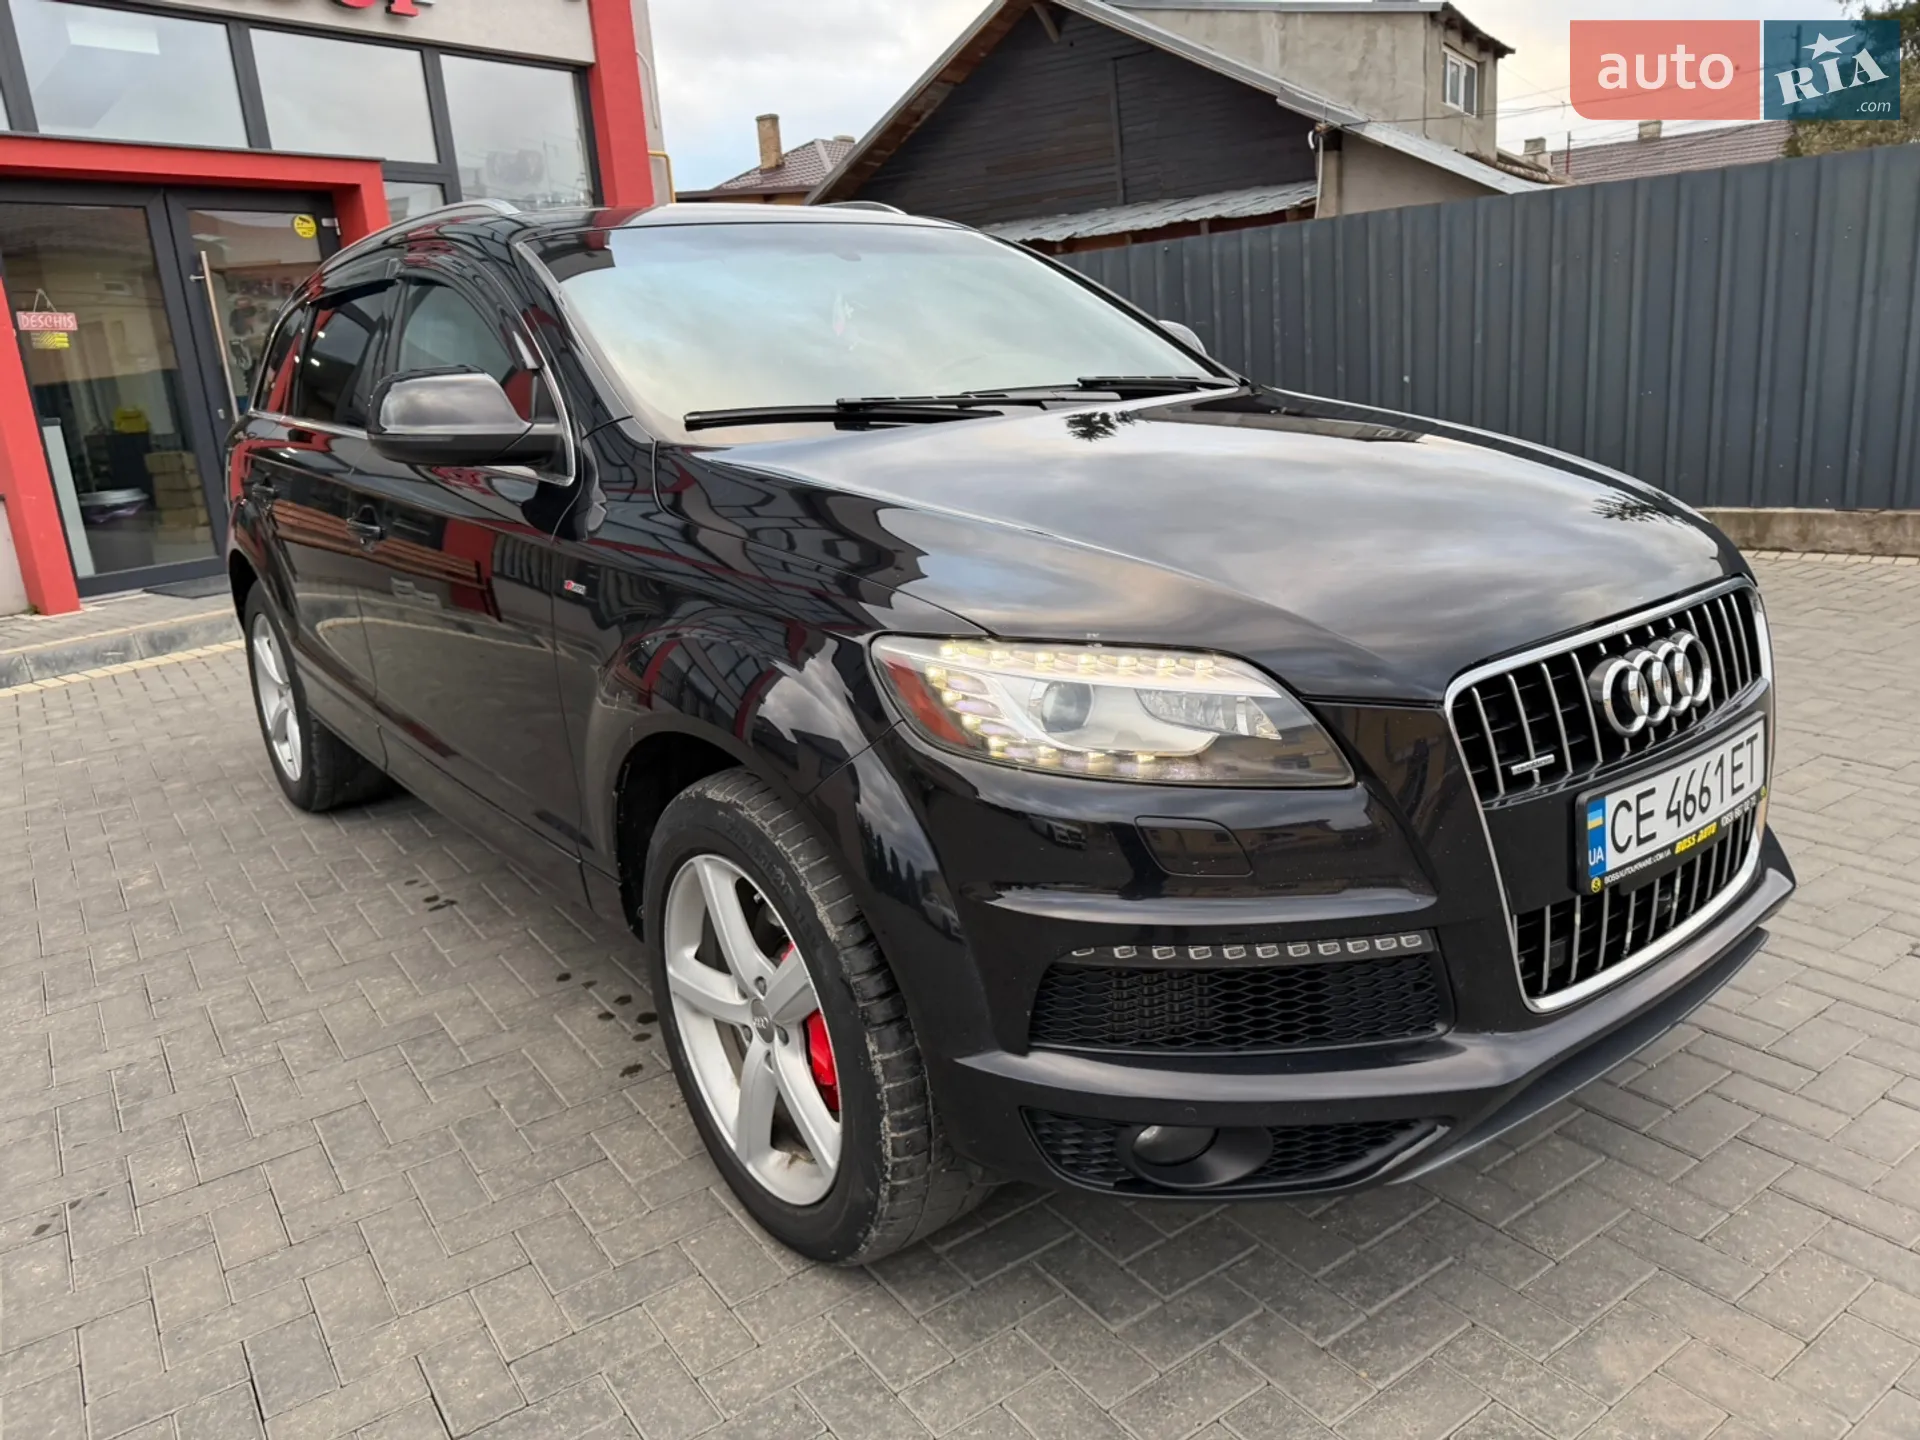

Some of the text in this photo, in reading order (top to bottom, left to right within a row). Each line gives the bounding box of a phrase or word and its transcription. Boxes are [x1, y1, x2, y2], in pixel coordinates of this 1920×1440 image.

[21, 314, 75, 328] DESCHIS
[1611, 787, 1657, 854] CE
[1588, 846, 1604, 866] UA
